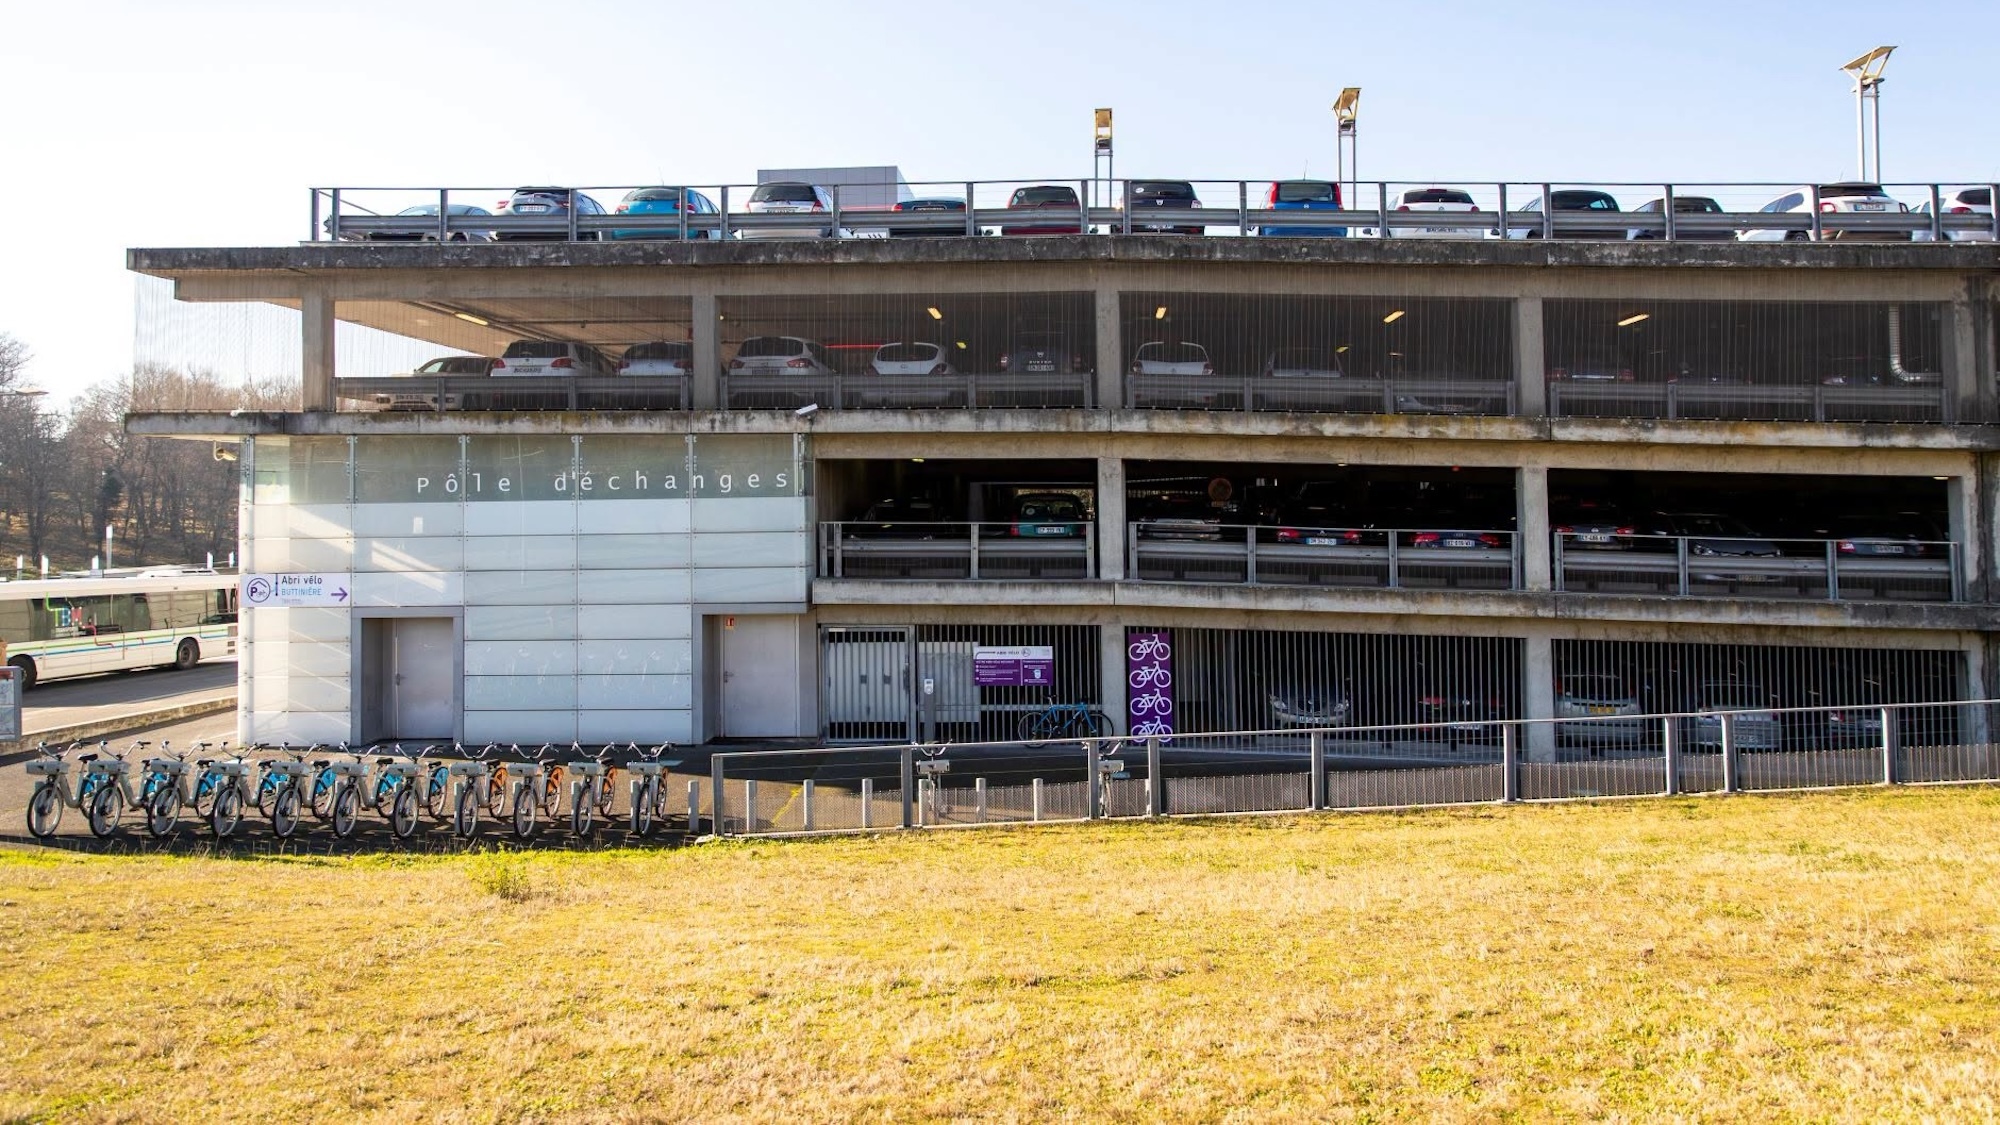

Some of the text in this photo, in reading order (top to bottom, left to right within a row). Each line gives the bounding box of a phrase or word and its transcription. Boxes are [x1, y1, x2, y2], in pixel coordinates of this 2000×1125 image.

[417, 471, 787, 493] Pôle d'échanges
[281, 575, 323, 585] Abri vélo
